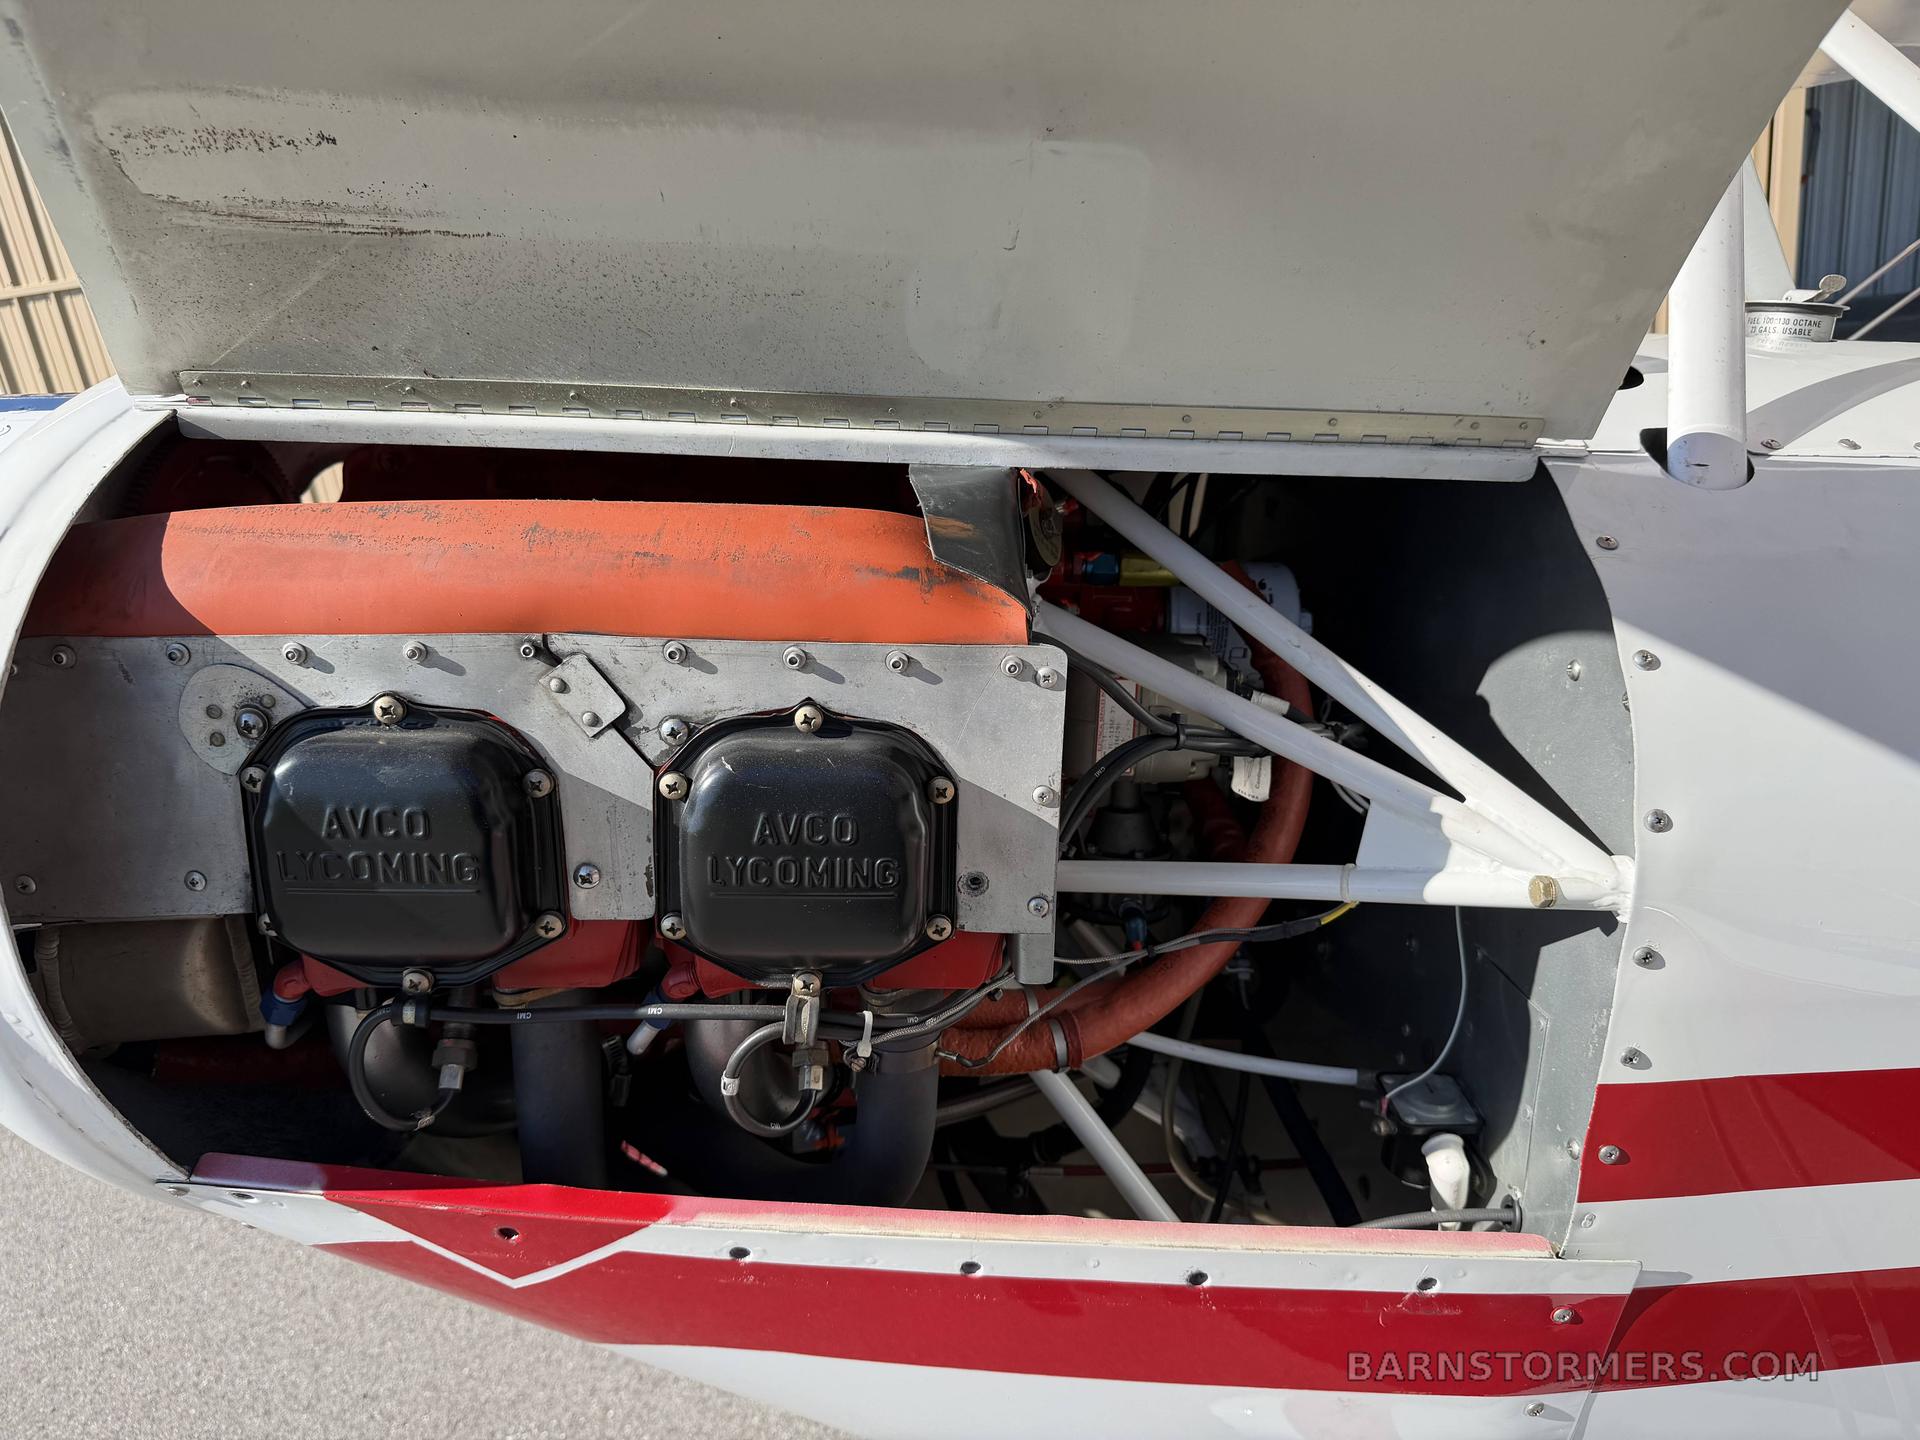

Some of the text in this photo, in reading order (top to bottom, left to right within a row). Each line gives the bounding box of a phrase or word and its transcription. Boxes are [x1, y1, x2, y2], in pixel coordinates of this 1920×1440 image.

[1792, 318, 1822, 328] OCTANE
[1782, 328, 1812, 336] USABLE
[1094, 766, 1106, 778] CMI
[321, 806, 432, 840] AVCO
[753, 812, 859, 846] AVCO
[277, 851, 480, 884] LYCOMING
[707, 856, 900, 889] LYCOMING
[516, 1012, 532, 1020] CMI
[647, 1007, 663, 1015] CMI
[906, 1016, 919, 1024] CMI
